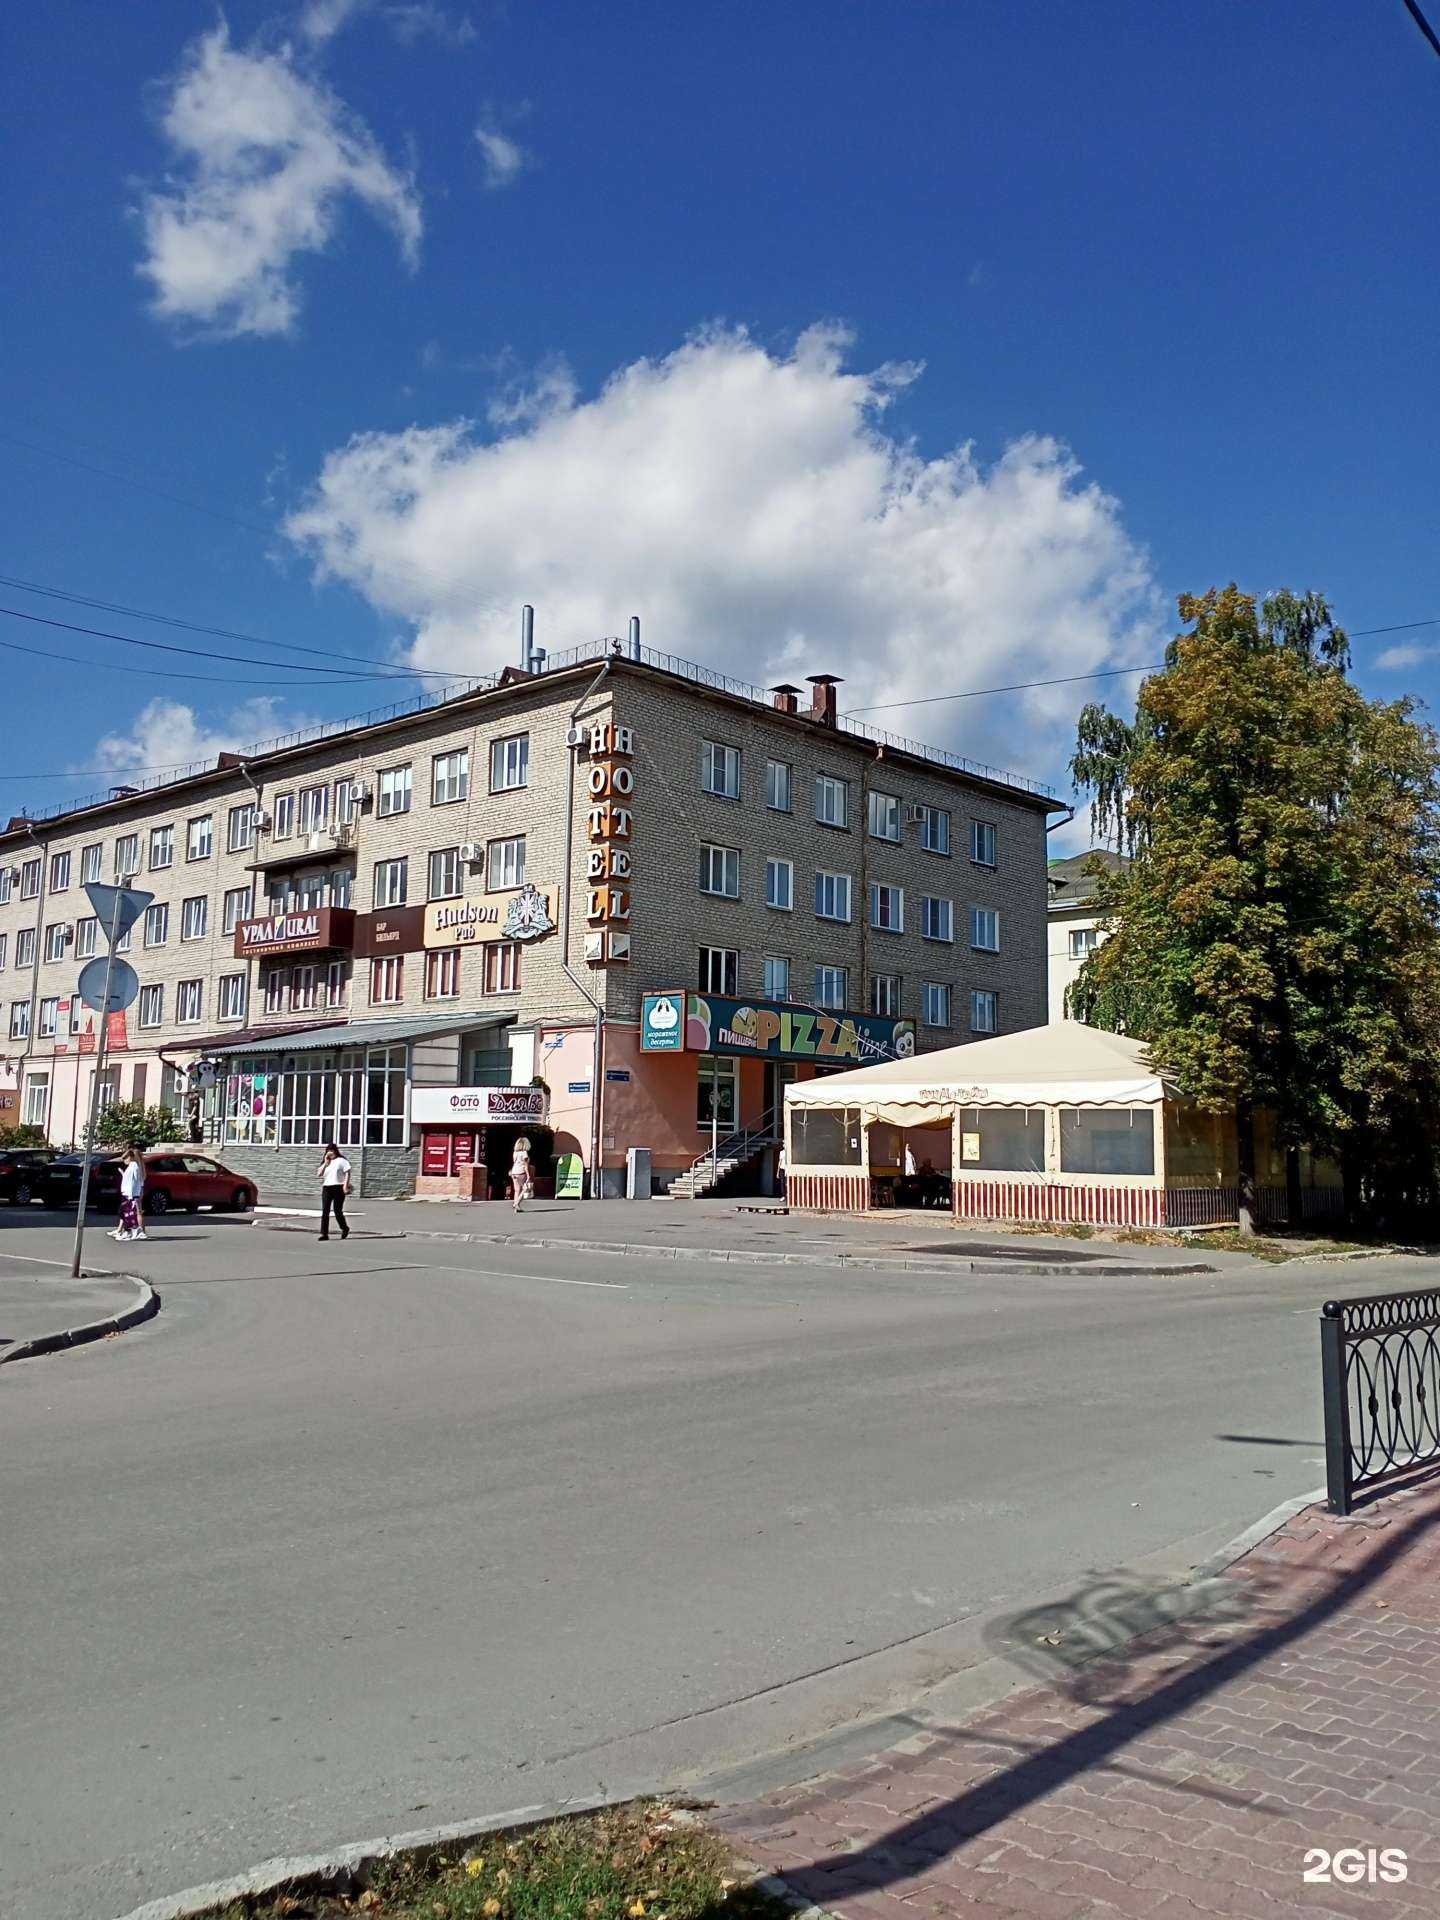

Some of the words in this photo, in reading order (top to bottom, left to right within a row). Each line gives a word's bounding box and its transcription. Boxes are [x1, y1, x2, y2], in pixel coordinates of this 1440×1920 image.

[586, 724, 607, 920] HOTEL
[609, 724, 634, 920] HOTEL
[287, 915, 320, 938] URAL
[435, 903, 498, 931] Hudson
[242, 922, 273, 944] УРАЛ
[454, 926, 476, 943] Pub
[756, 1009, 859, 1057] PIZZA
